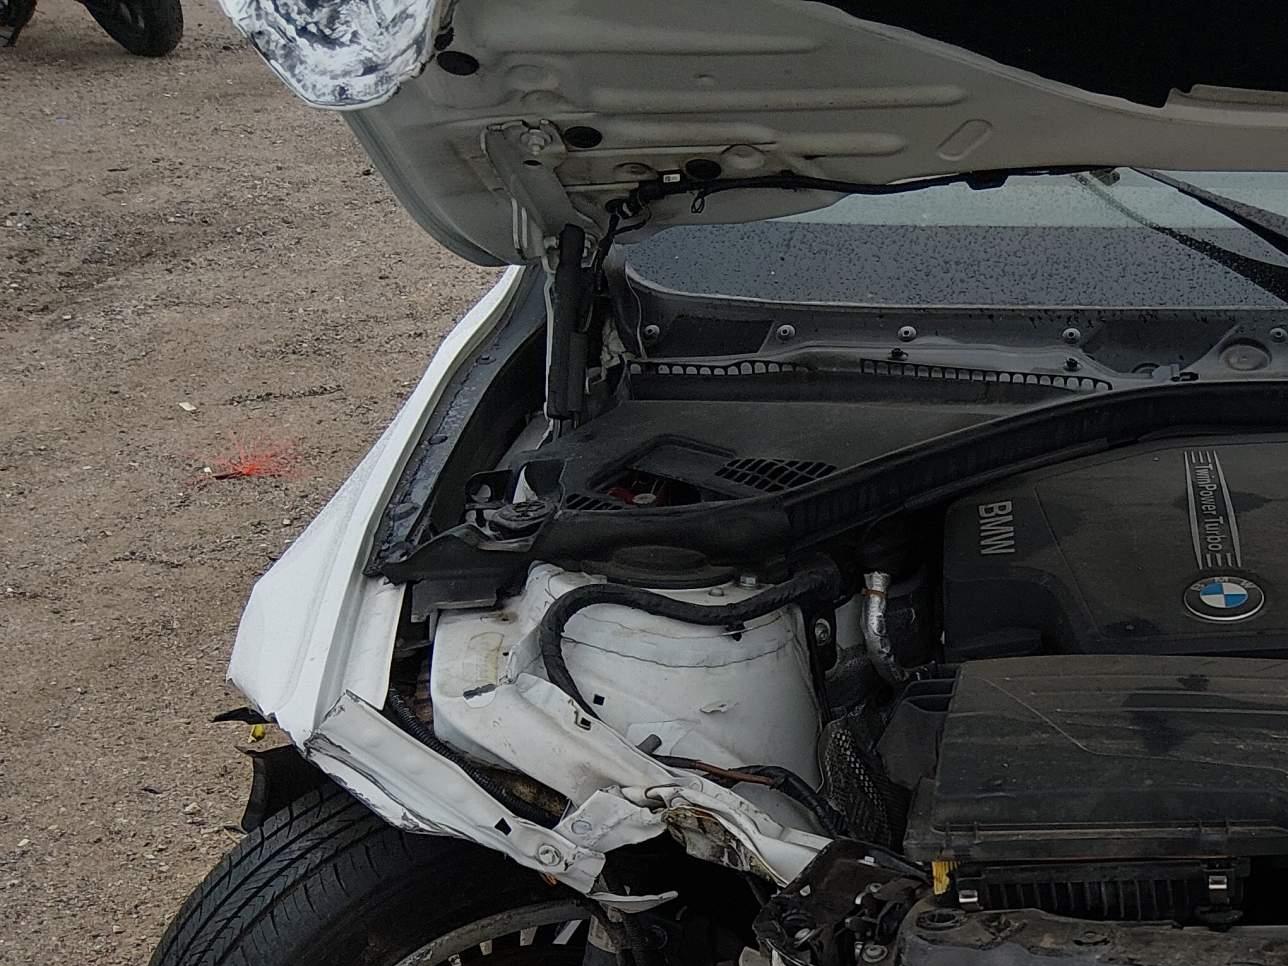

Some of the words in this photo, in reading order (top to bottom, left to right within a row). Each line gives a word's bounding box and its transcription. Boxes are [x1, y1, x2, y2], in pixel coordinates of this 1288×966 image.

[1195, 463, 1217, 515] TwinPower
[979, 501, 1015, 554] BMW
[1203, 516, 1227, 551] Turbo
